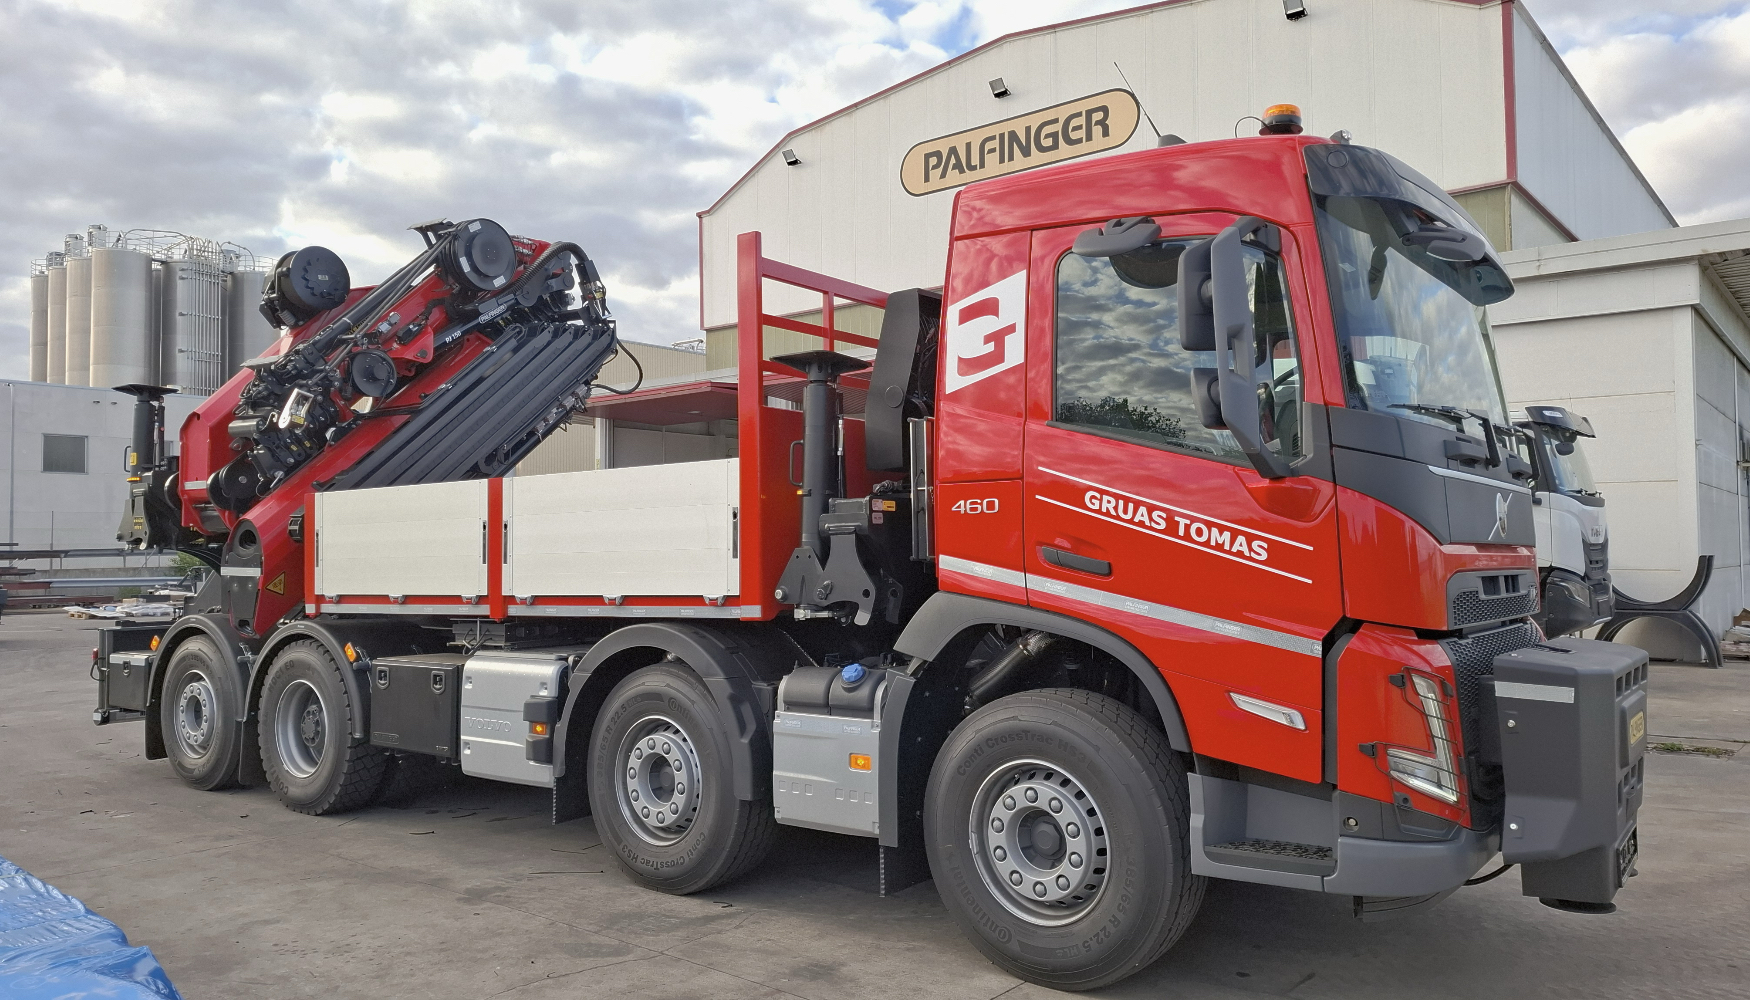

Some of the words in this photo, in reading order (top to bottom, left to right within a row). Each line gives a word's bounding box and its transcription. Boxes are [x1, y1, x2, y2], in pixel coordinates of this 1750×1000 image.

[923, 104, 1110, 184] PALFINGER
[951, 498, 999, 515] 460
[1084, 490, 1167, 530] GRUAS
[1174, 516, 1268, 561] TOMAS
[465, 716, 512, 733] VOLVO
[610, 703, 627, 725] 22.5
[956, 744, 984, 777] Conti
[985, 730, 1054, 749] CrossTrac
[1057, 738, 1087, 764] HS3
[621, 843, 639, 864] HS3
[686, 831, 706, 859] Conti
[639, 855, 686, 871] CrossTrac
[1117, 857, 1136, 919] 385/65
[947, 864, 1013, 947] Continental
[1109, 916, 1122, 931] R
[1078, 928, 1112, 957] 22.5
